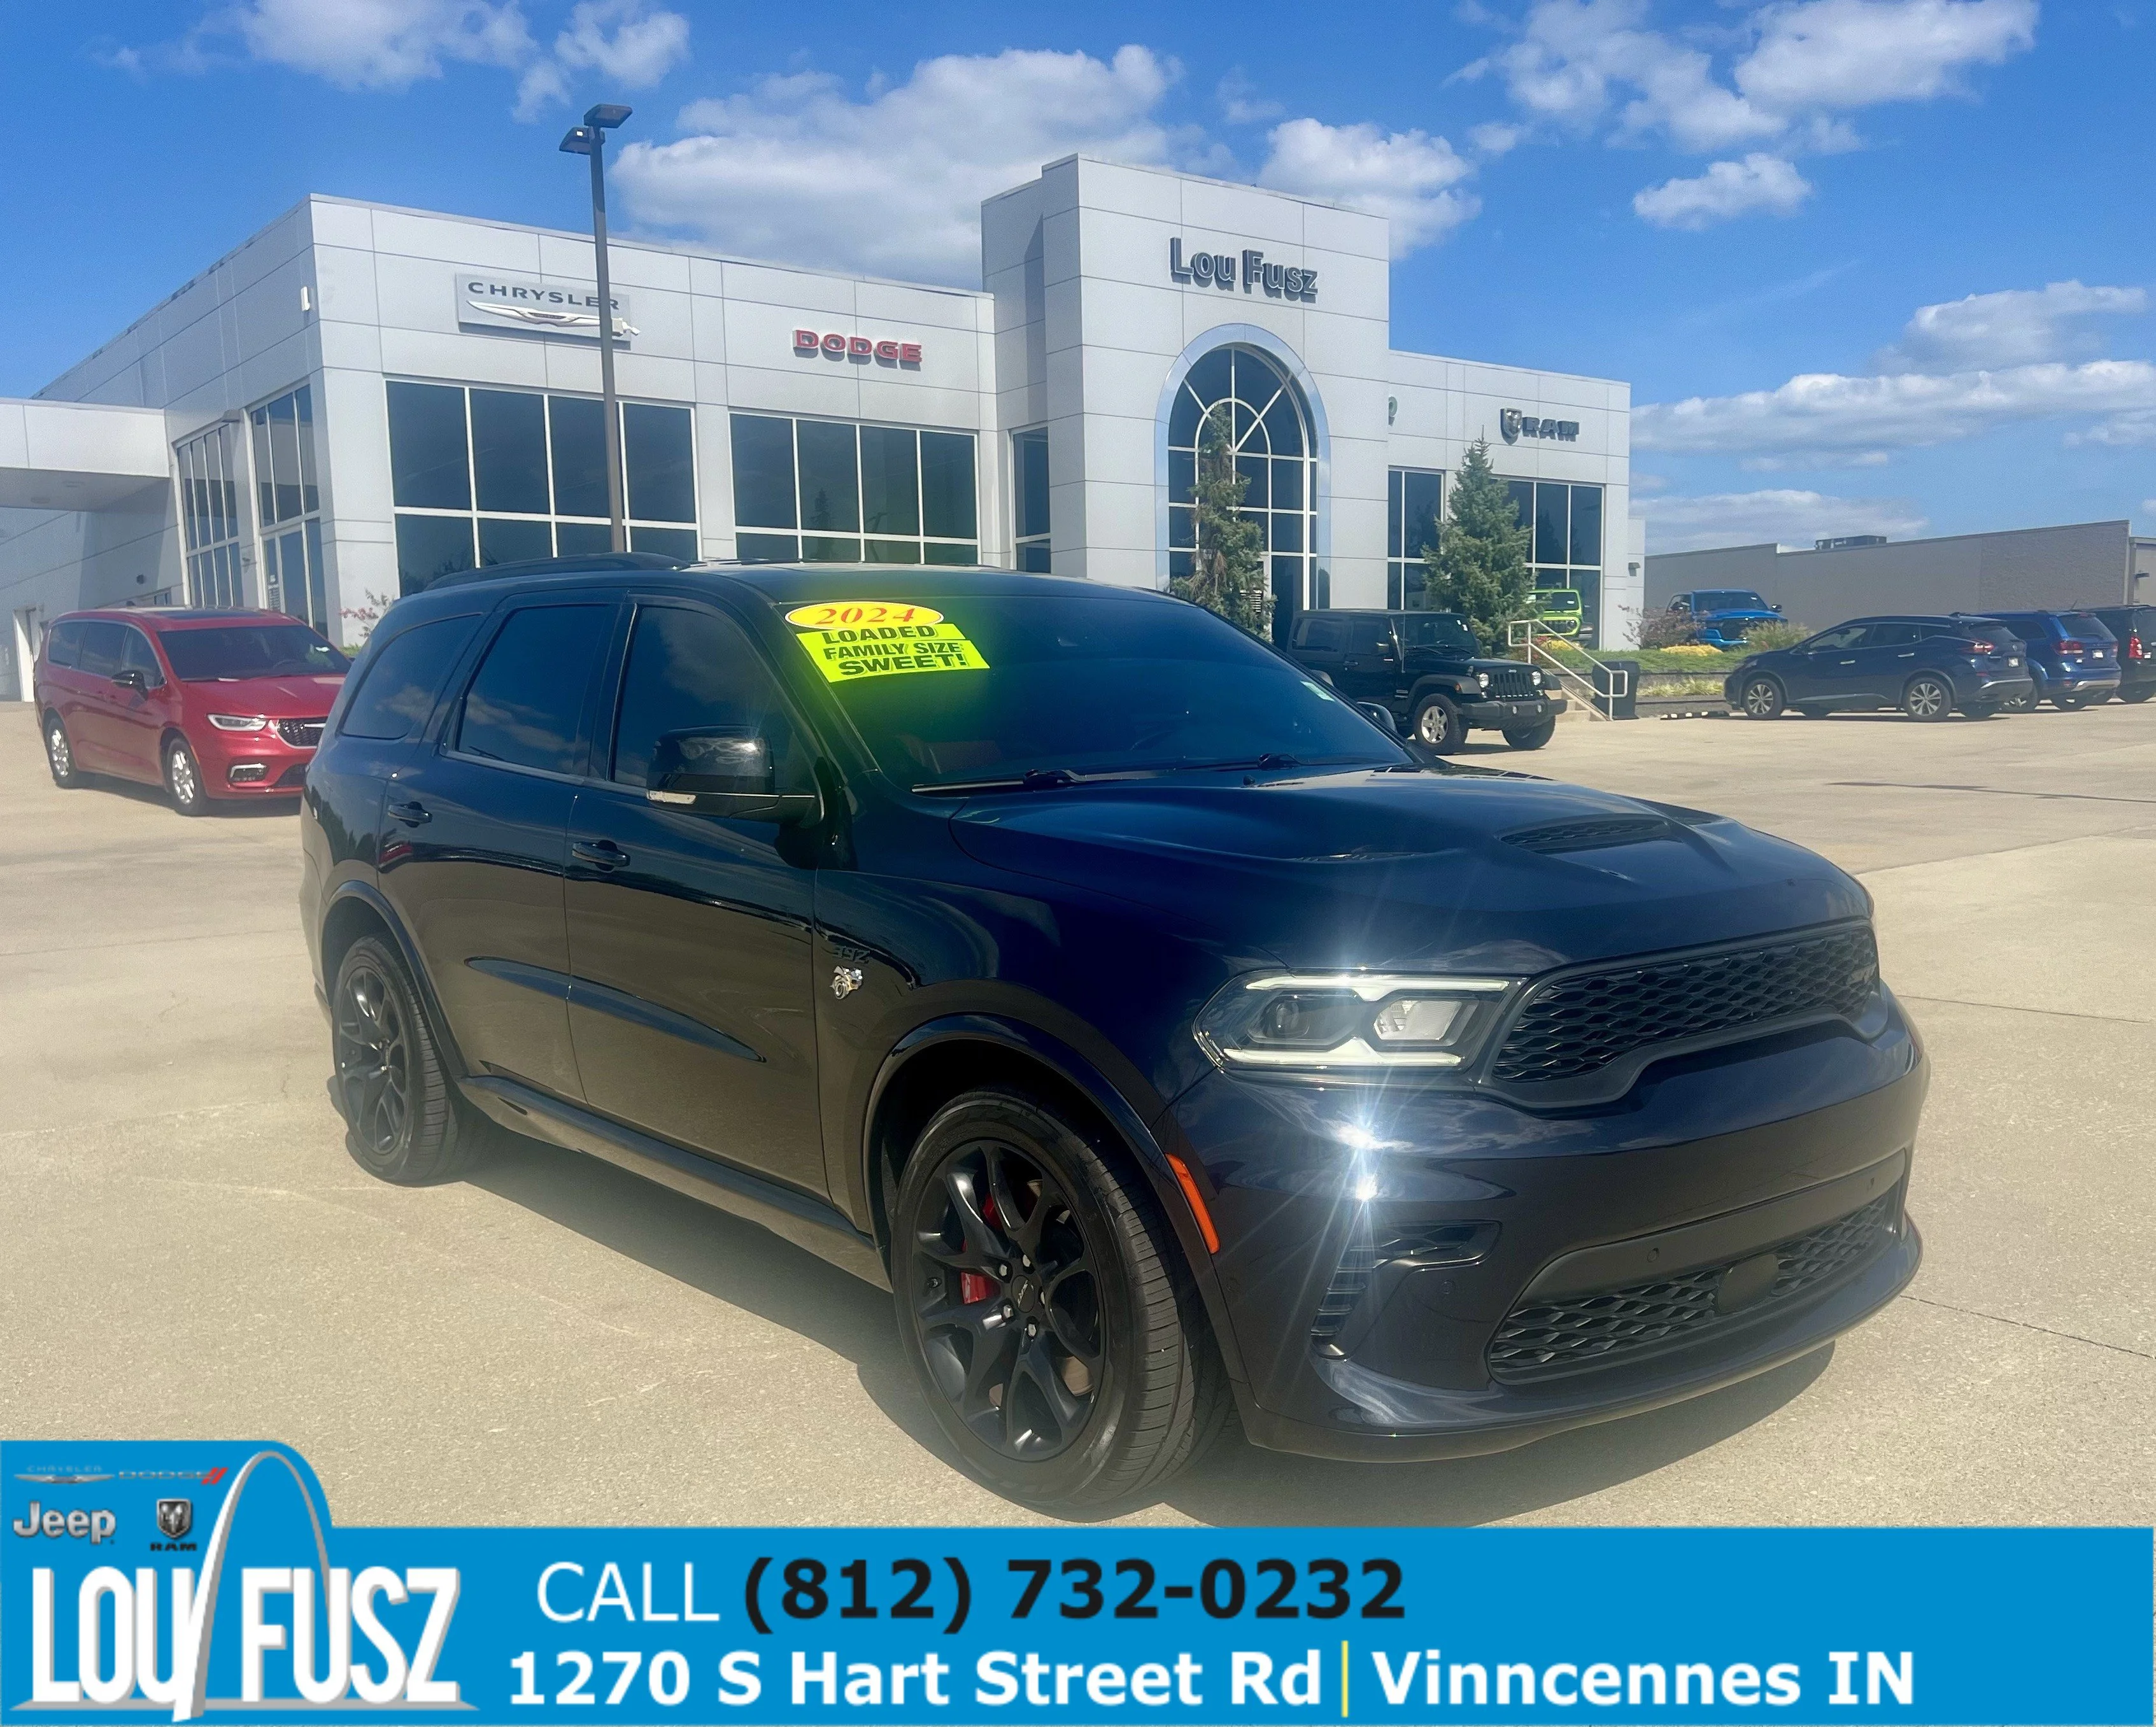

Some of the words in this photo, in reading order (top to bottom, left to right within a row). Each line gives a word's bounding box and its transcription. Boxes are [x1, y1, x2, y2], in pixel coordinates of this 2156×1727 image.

[1170, 236, 1237, 283] Lou
[1242, 248, 1319, 295] Fusz
[792, 328, 923, 363] DODGE
[1522, 416, 1580, 435] RAM
[815, 607, 917, 625] 2024
[821, 625, 939, 644] LOADED
[823, 642, 909, 661] FAMILY
[912, 642, 965, 654] SIZE
[837, 654, 969, 676] SWEET!
